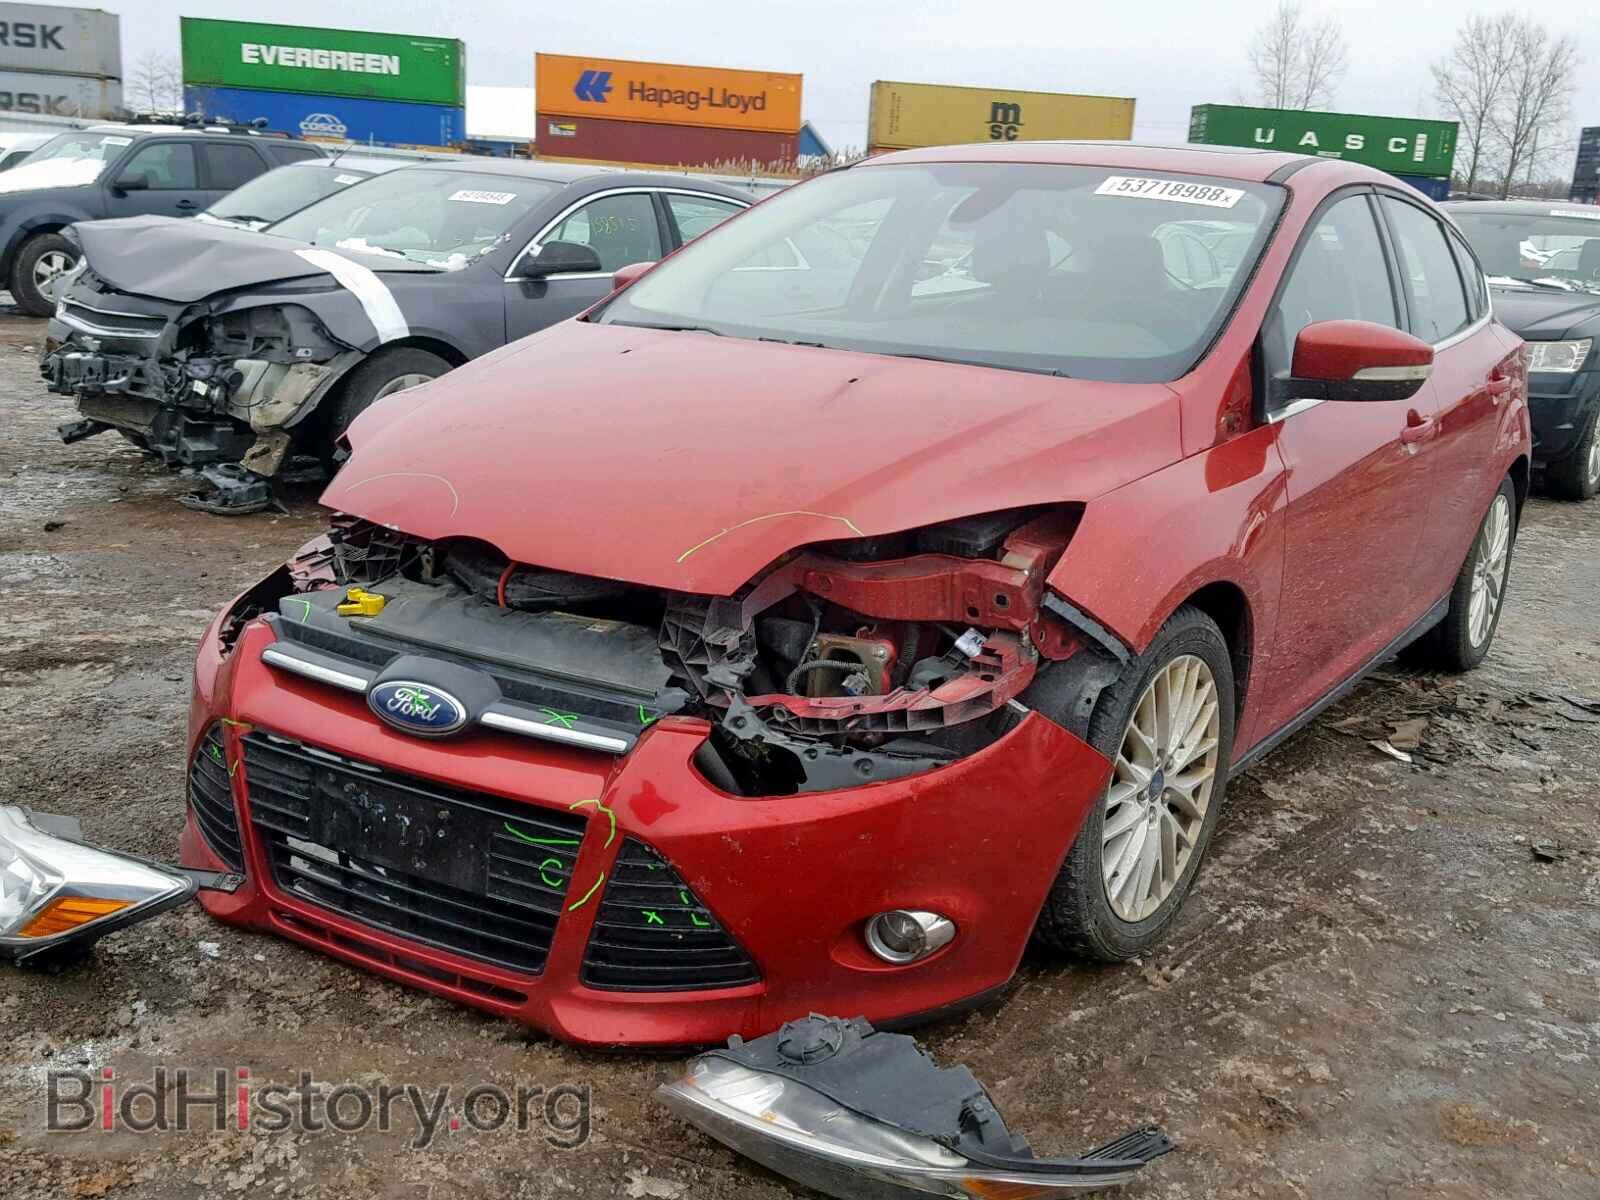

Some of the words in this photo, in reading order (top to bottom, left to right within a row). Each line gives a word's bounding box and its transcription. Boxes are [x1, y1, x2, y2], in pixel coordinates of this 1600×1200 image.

[241, 42, 400, 75] EVERGREEN
[628, 80, 766, 113] Hapag-Lloyd
[299, 121, 347, 133] COSCO
[387, 687, 440, 722] Ford
